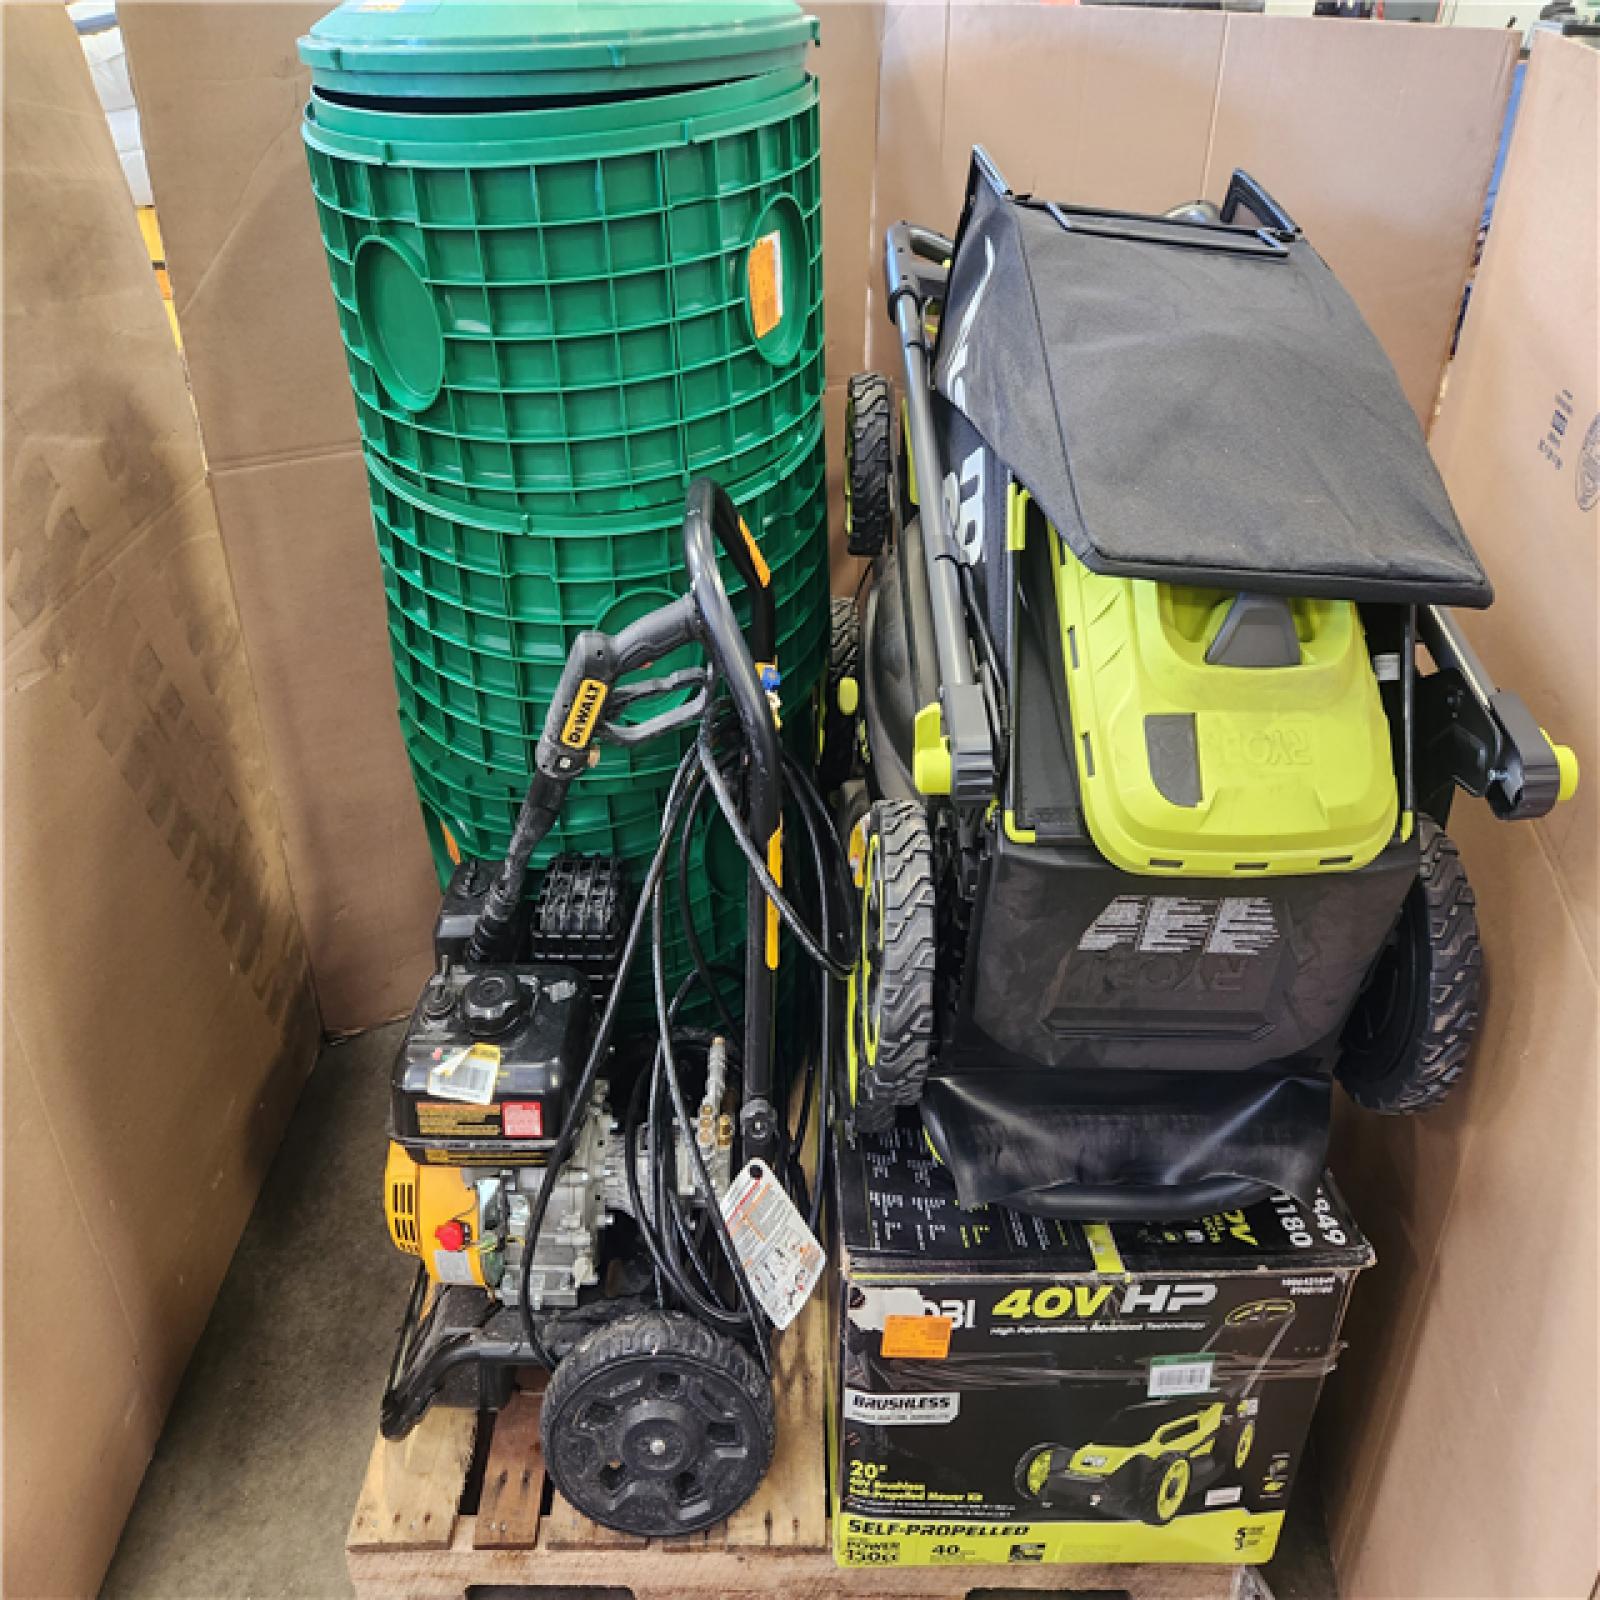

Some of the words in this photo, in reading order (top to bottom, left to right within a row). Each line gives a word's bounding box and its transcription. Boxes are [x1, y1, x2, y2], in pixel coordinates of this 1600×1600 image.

[569, 684, 600, 743] DEWALT
[991, 1285, 1114, 1319] 40V
[1119, 1284, 1218, 1314] HP
[848, 1519, 1030, 1536] SELF-PROPELLED
[931, 1544, 961, 1555] 40
